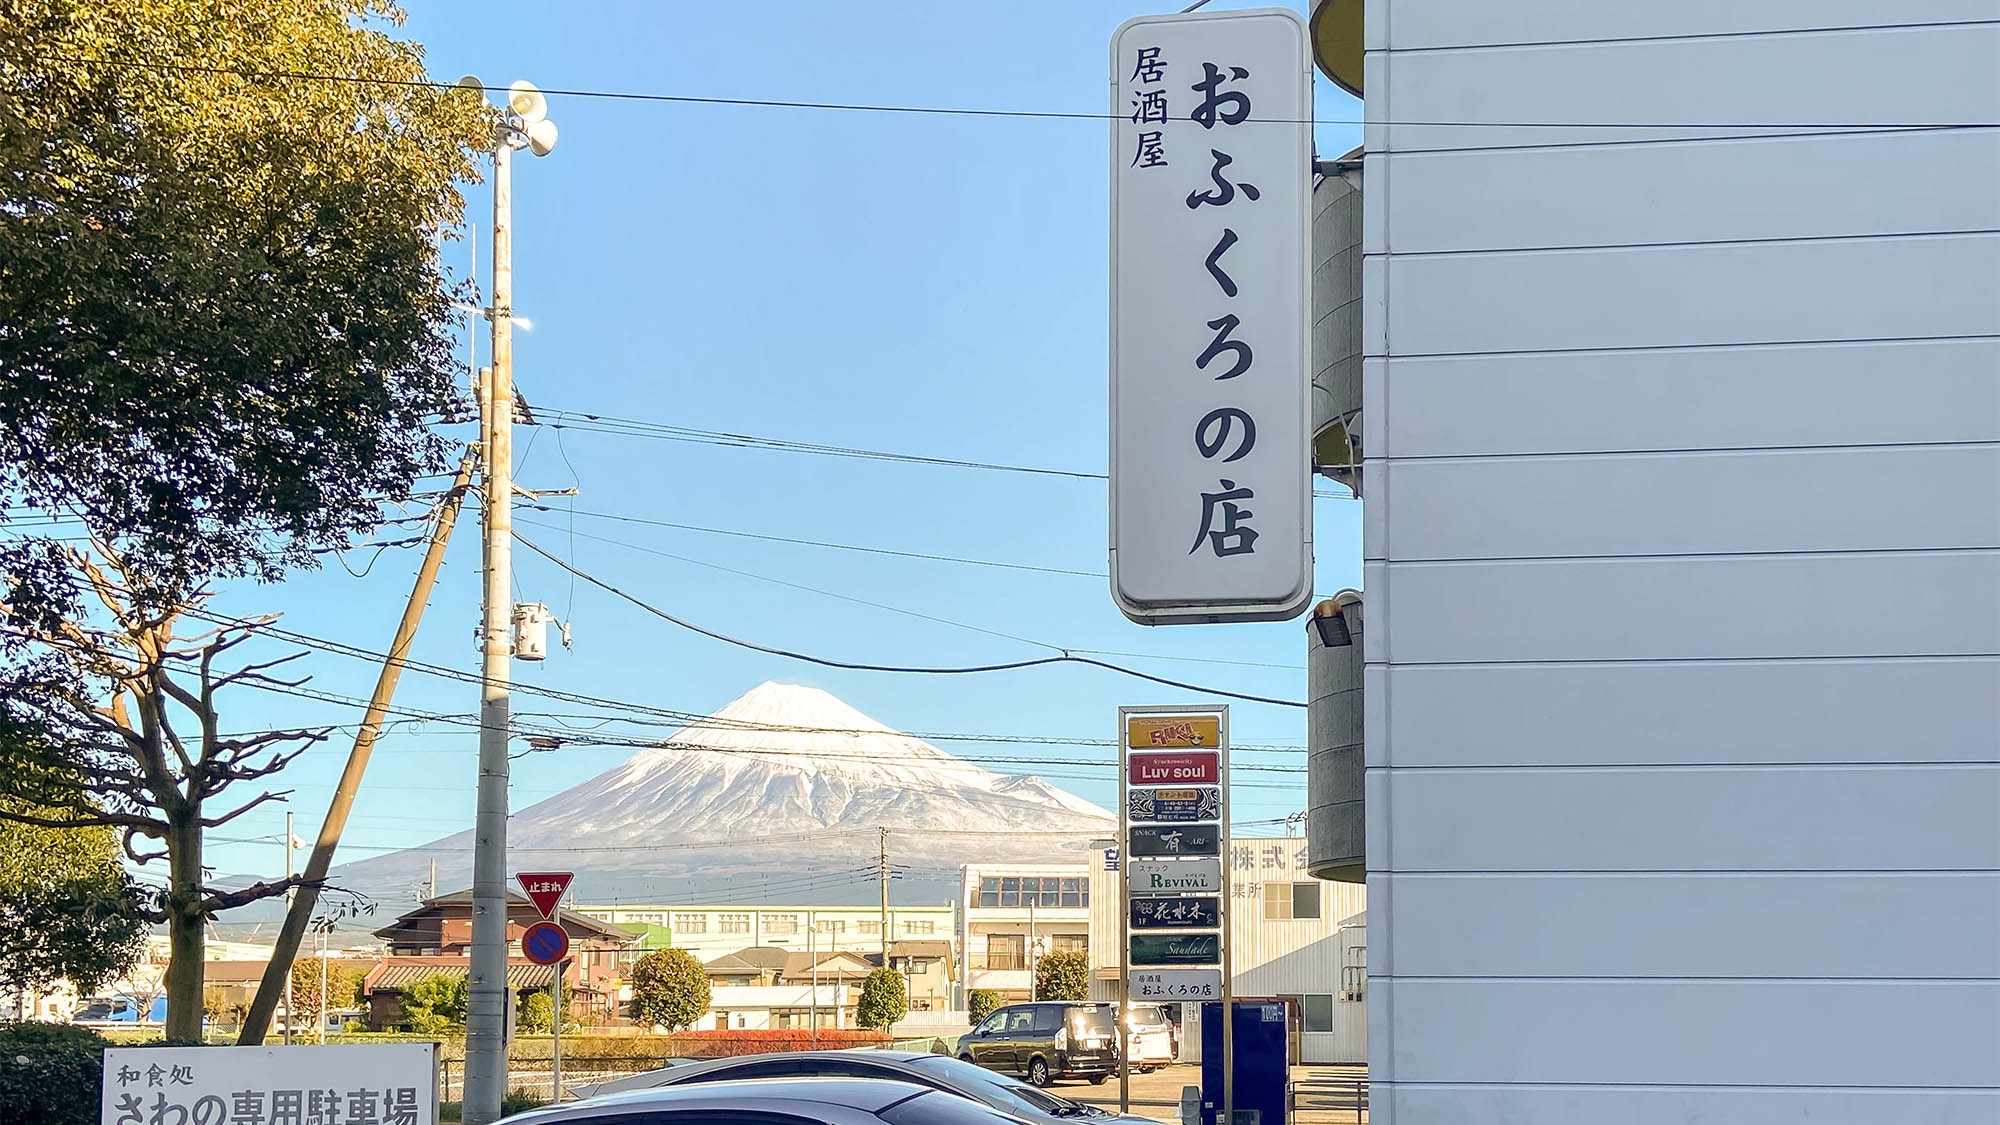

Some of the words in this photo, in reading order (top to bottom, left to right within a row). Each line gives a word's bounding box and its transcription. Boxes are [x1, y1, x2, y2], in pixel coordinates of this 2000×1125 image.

[1129, 46, 1168, 169] 居酒屋
[1186, 62, 1261, 558] おふくろの店
[1142, 765, 1169, 779] Luv
[1173, 764, 1206, 778] soul
[1134, 829, 1157, 837] SNACK
[1160, 830, 1183, 854] 有
[529, 881, 562, 893] 止まれ
[1153, 901, 1206, 920] 花水木
[1165, 937, 1213, 955] Saudade
[1138, 974, 1162, 983] 居酒屋
[1142, 984, 1212, 996] おふくろの店
[117, 1062, 194, 1088] 和食処
[114, 1088, 418, 1125] さわの専用駐車場
